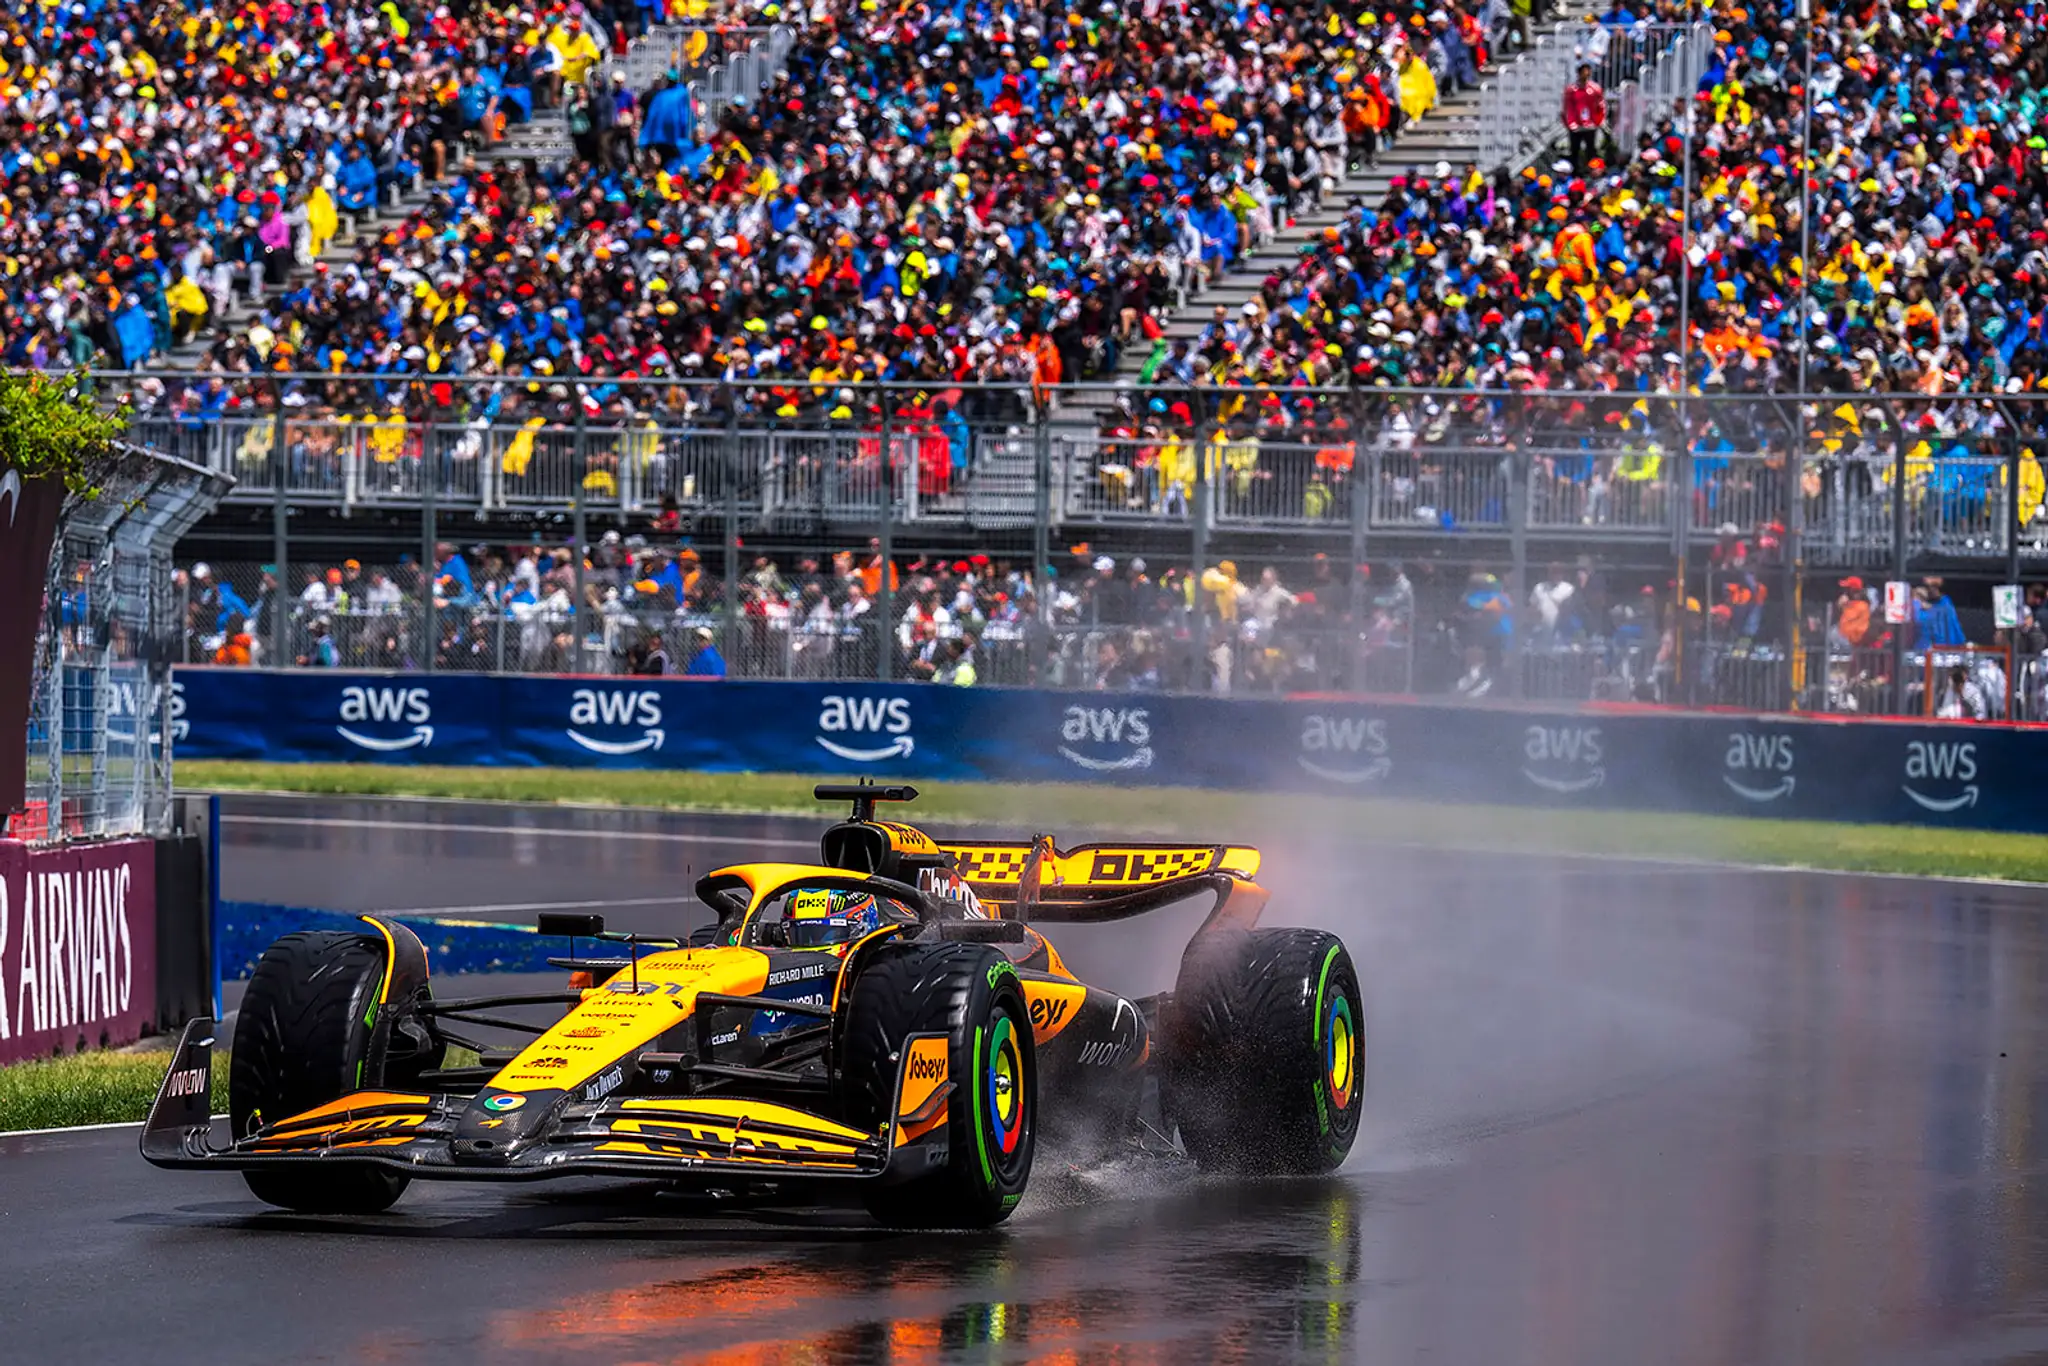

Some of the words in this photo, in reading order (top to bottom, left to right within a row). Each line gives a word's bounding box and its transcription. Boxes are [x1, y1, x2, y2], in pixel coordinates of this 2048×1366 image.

[340, 686, 431, 723] aws
[570, 689, 662, 726] aws
[819, 695, 911, 733] aws
[1061, 704, 1150, 744] aws
[1301, 715, 1388, 753] aws
[1525, 725, 1601, 763] aws
[1726, 733, 1794, 771] aws
[1905, 741, 1977, 780] aws
[953, 852, 1030, 880] KX
[1090, 852, 1208, 880] OKX
[17, 863, 131, 1036] AIRWAYS
[769, 968, 800, 985] RICHARD
[802, 964, 824, 979] MILLE
[1030, 999, 1068, 1030] eys
[909, 1051, 945, 1083] Sobeys
